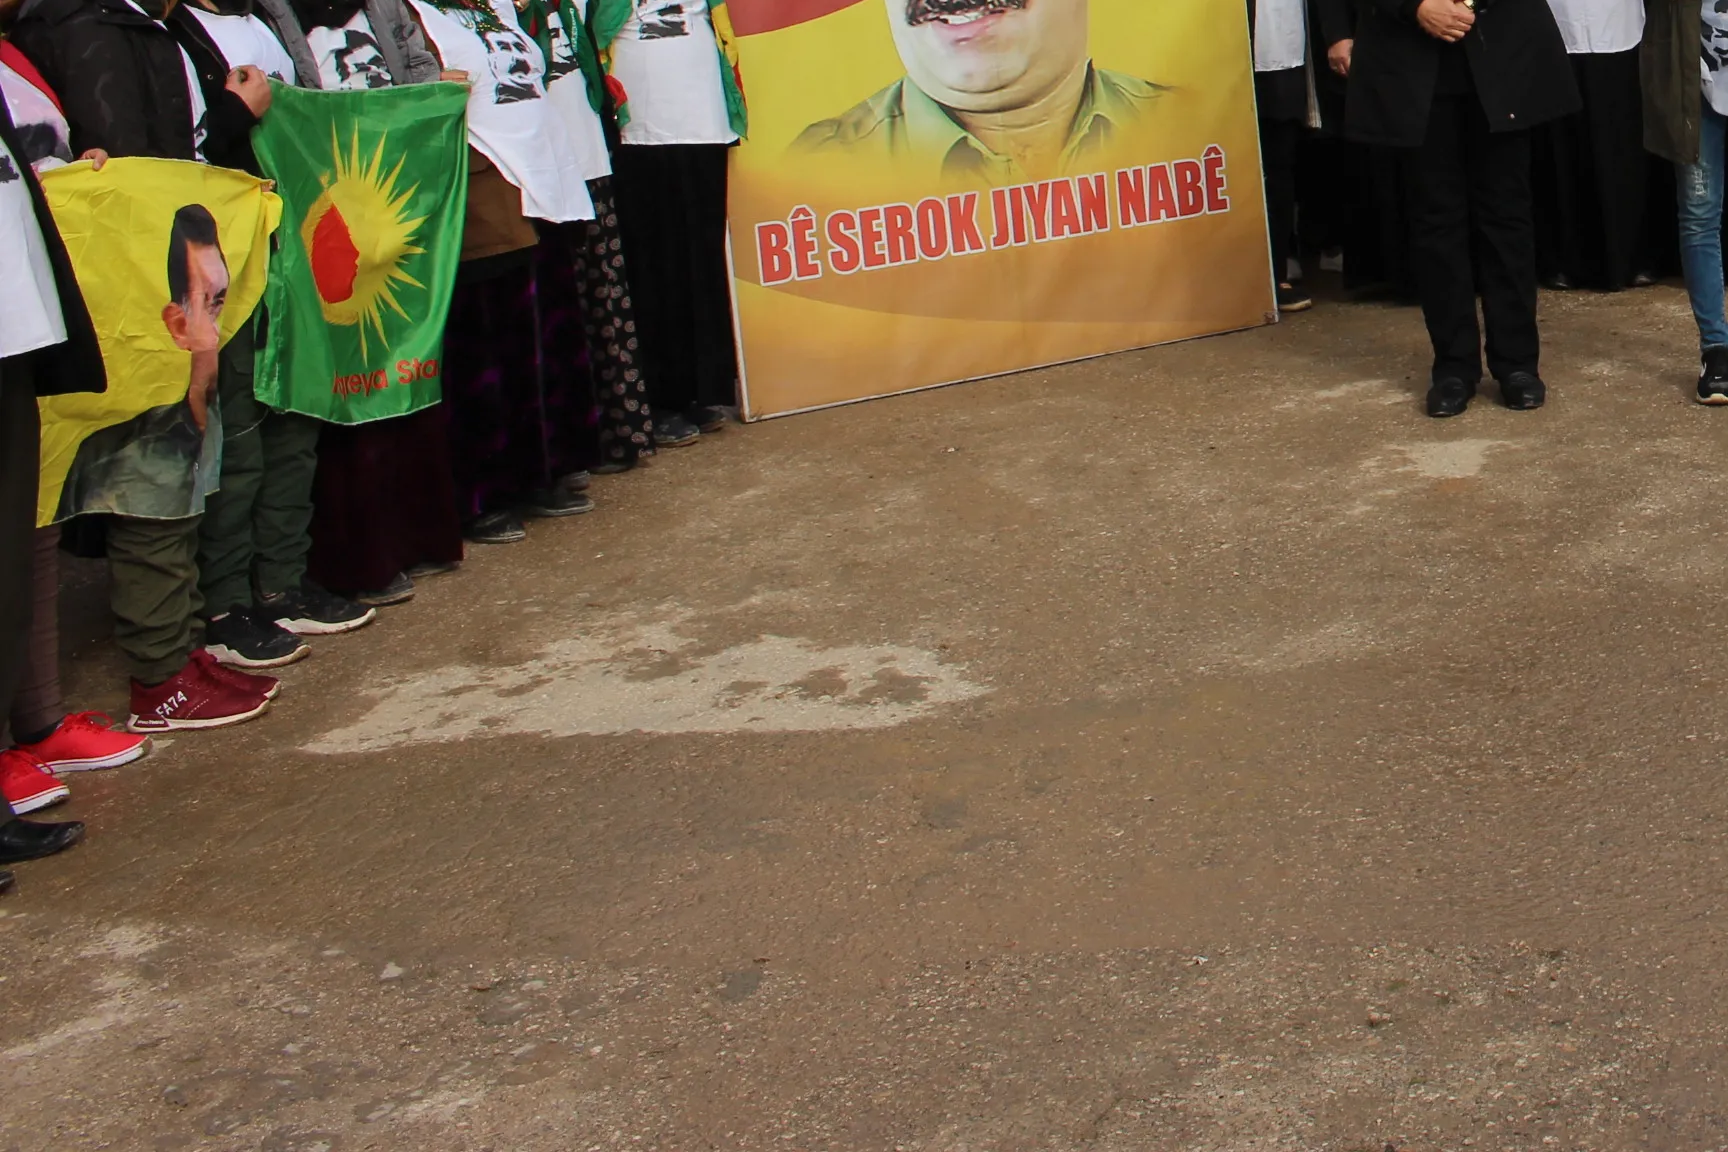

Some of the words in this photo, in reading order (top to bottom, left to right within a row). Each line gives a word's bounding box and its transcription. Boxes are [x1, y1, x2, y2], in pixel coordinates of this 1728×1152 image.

[755, 205, 820, 286] BÊ
[826, 191, 985, 276] SEROK
[990, 172, 1110, 251] JIYAN
[1115, 144, 1230, 229] NABÊ
[395, 358, 440, 385] Sta
